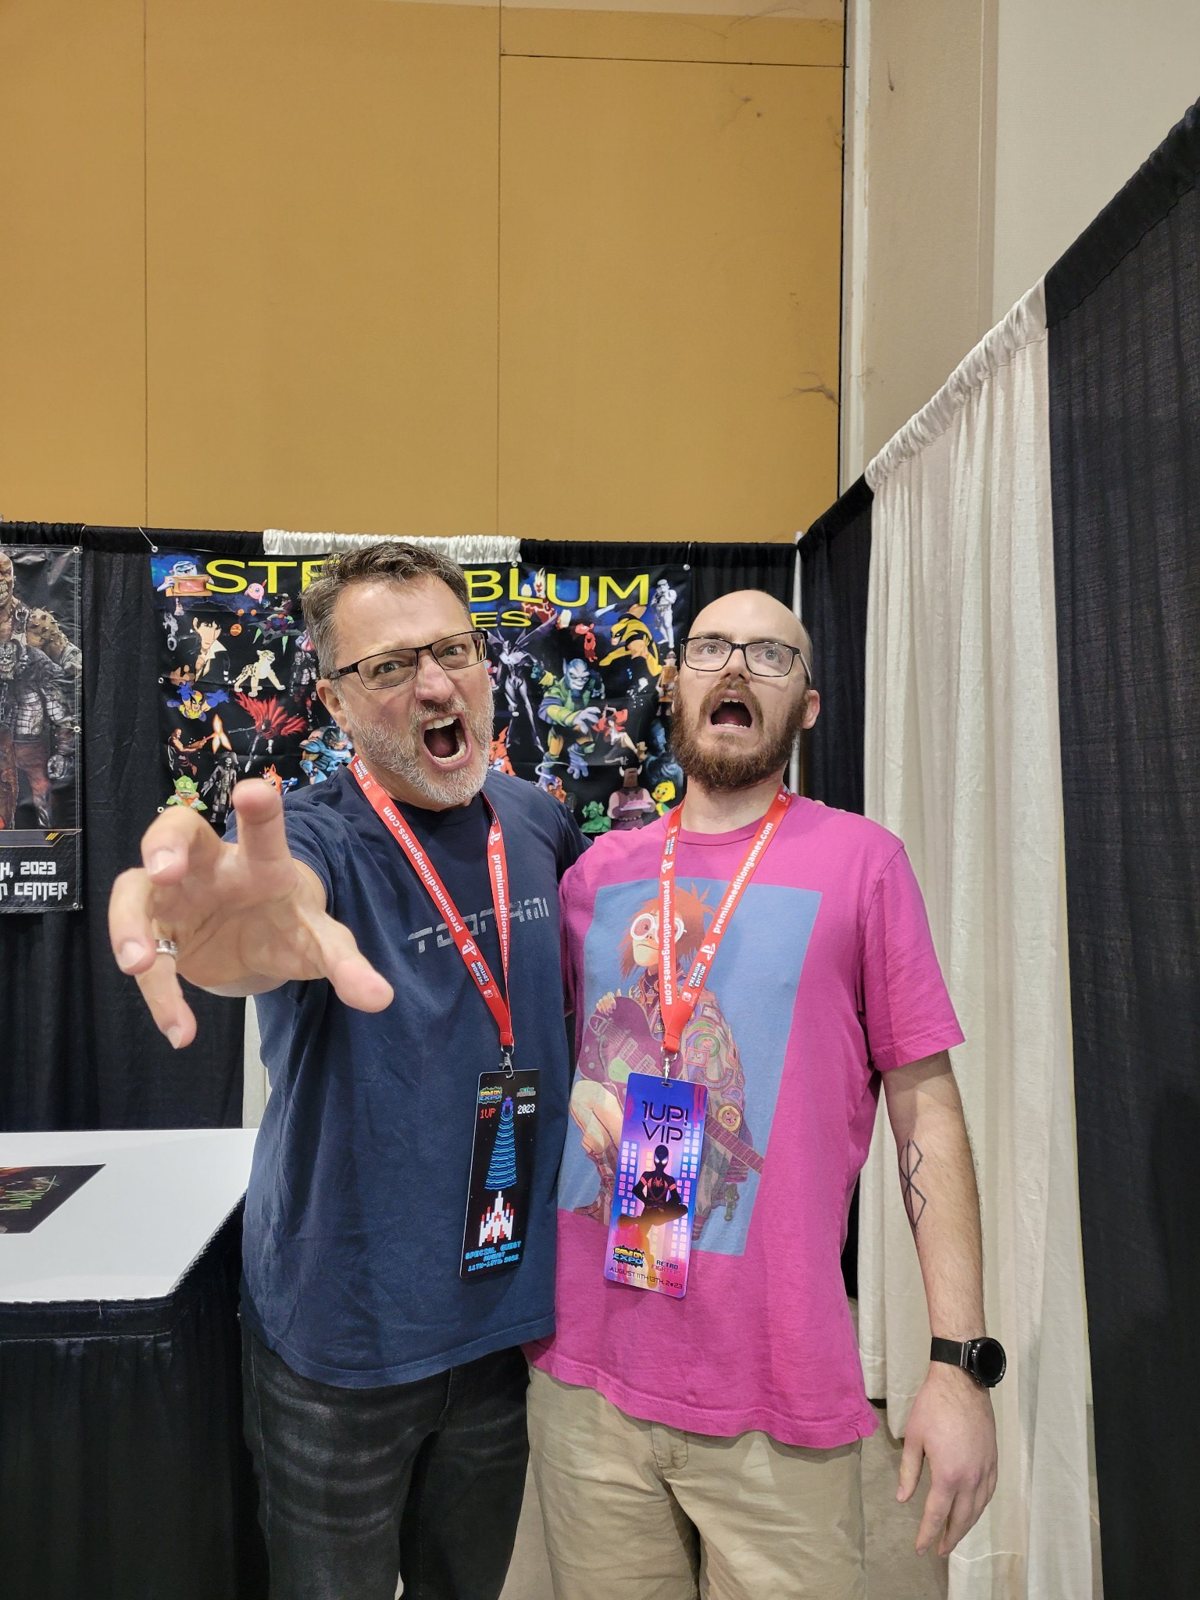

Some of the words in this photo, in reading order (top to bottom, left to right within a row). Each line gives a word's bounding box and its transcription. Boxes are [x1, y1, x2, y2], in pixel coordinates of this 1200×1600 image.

[464, 568, 650, 608] BLUM
[20, 861, 56, 875] 2023
[383, 806, 464, 933] premiumeditiongames.com
[712, 822, 774, 934] premiumeditiongames.com
[14, 882, 68, 901] CENTER
[661, 880, 674, 1005] premiumeditiongames.com
[479, 1107, 496, 1119] 1UP
[517, 1103, 536, 1115] 2023
[642, 1100, 689, 1126] 1UP!
[642, 1121, 683, 1144] VIP
[613, 1253, 644, 1265] EXPO
[656, 1259, 679, 1270] RETRO
[609, 1266, 635, 1278] AUGUST
